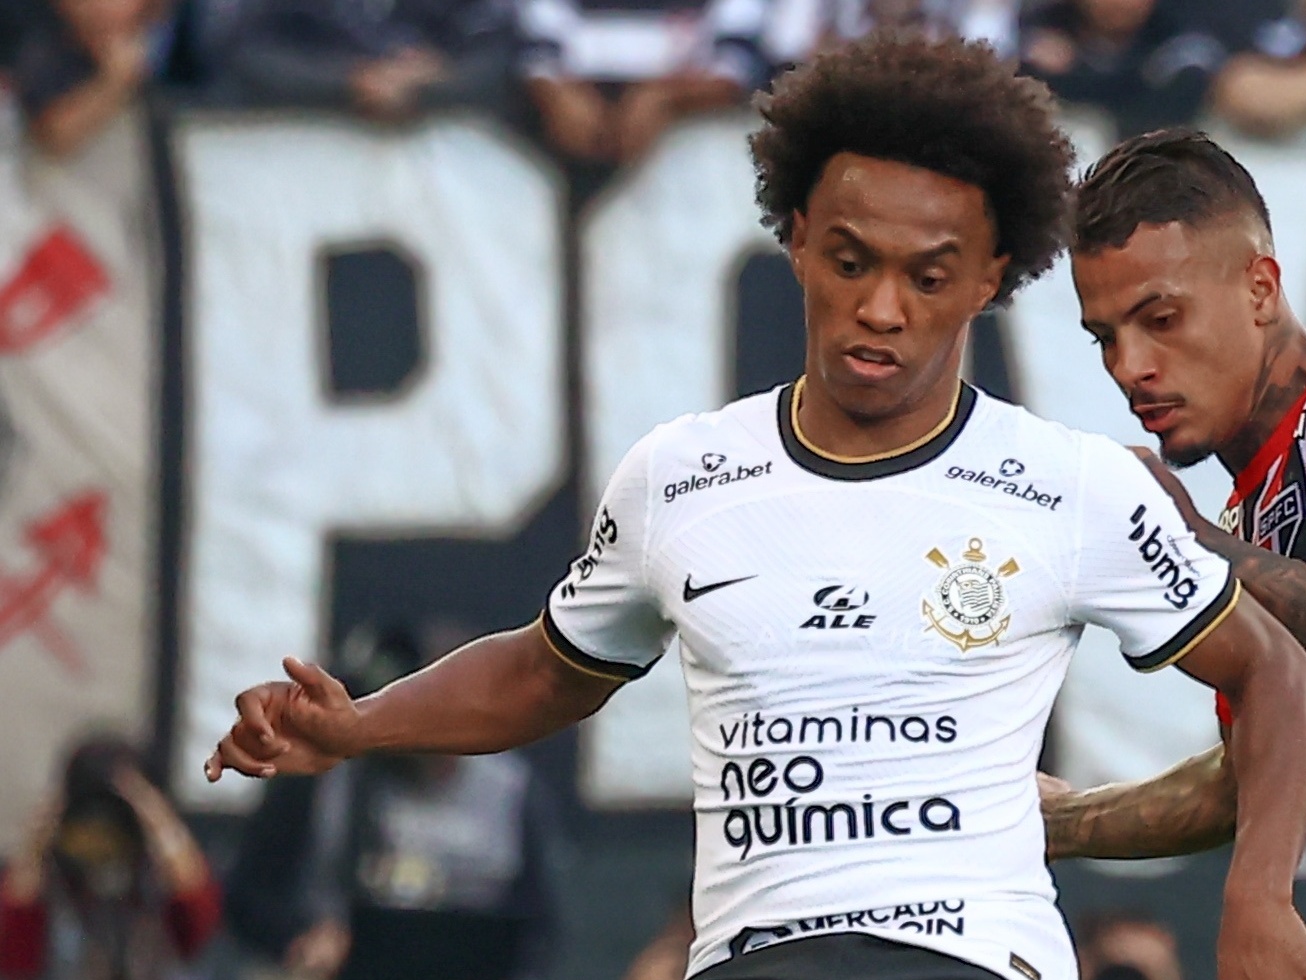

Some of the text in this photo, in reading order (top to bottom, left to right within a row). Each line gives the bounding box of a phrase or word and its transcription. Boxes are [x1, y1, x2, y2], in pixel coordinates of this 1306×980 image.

[664, 461, 773, 503] galera.bet
[945, 465, 1063, 511] galera.bet
[1260, 496, 1296, 536] SPFC
[1138, 525, 1199, 609] bmg
[799, 614, 877, 629] ALE
[720, 707, 957, 749] vitaminas
[721, 755, 824, 801] neo
[723, 794, 961, 861] química
